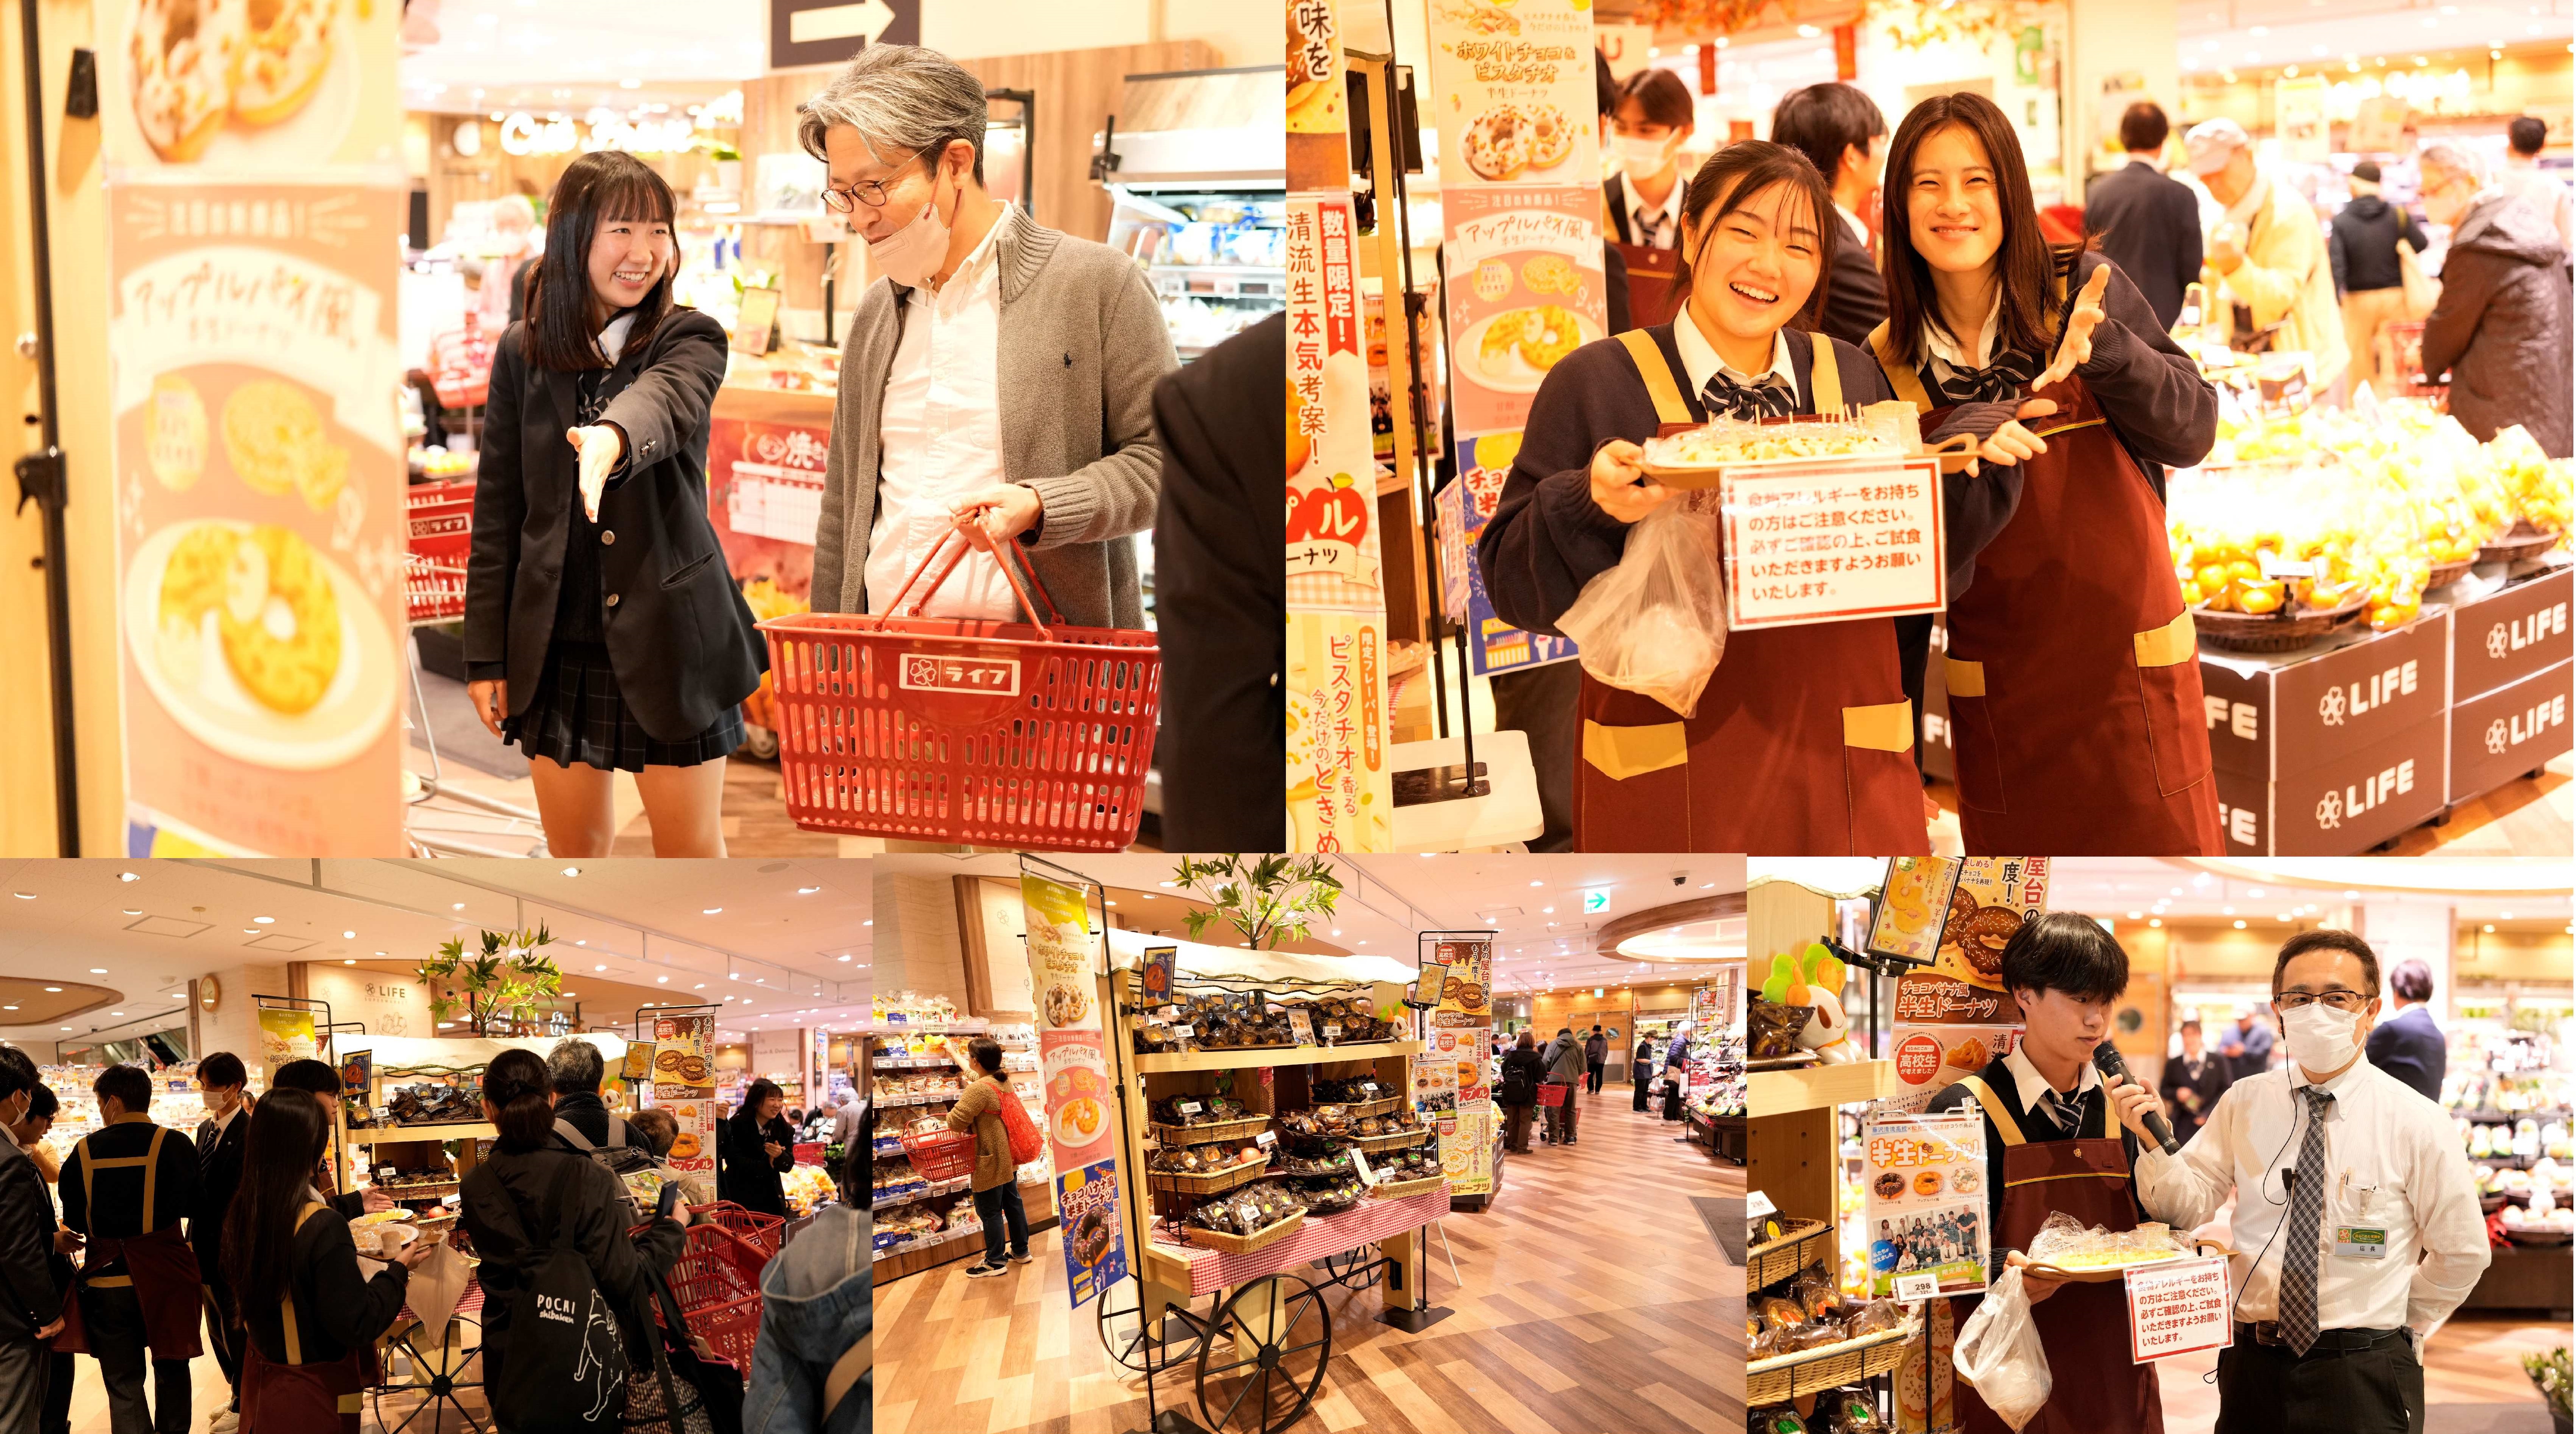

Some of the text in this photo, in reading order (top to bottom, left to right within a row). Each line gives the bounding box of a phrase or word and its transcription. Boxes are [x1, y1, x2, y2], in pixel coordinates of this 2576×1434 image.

[1300, 1, 1332, 77] 味を
[1475, 62, 1559, 84] ピスタチオ
[1487, 87, 1548, 99] 半生ドーナツ
[1466, 215, 1585, 242] アップルパイ風
[431, 519, 465, 532] ライフ
[1749, 508, 1914, 531] の方はご注意ください。
[1750, 529, 1921, 555] 必ずご確認の上、ご試食
[1751, 552, 1921, 577] いただきますようお願い
[1752, 581, 1836, 601] いたします。
[2510, 602, 2567, 651] LIFE
[945, 667, 1006, 684] ライフ
[1361, 632, 1379, 763] 限定フレーバー登場!
[2351, 659, 2418, 716] LIFE
[1330, 635, 1358, 815] ピスタチオ香る
[2510, 694, 2565, 745] LIFE
[2346, 758, 2415, 818] LIFE
[2002, 862, 2020, 902] 度!
[1481, 944, 1490, 1005] あの屋台の味を
[380, 986, 405, 998] LIFE
[1901, 980, 1970, 997] チョコバナナ風
[1898, 995, 1998, 1018] 半生ドーナツ
[1437, 1017, 1476, 1026] 半生ドーナツ
[703, 1018, 714, 1077] あの屋台の味を
[1050, 1042, 1097, 1063] アップルパイ風
[1900, 1054, 1936, 1068] 高校生
[655, 1090, 698, 1098] 半生ドーナツ
[1459, 1099, 1482, 1107] 半生ドーナツ
[1870, 1138, 1980, 1168] 半生ドーナツ
[1061, 1176, 1116, 1207] チョコバナナ風
[1065, 1189, 1113, 1219] 半生ドーナツ
[1942, 1265, 1974, 1275] 限定販売!
[537, 1294, 576, 1314] POCHI
[2140, 1287, 2217, 1305] の方はご注意ください。
[539, 1310, 575, 1324] shibaken
[2141, 1298, 2221, 1320] 必ずご確認の上、ご試食
[2142, 1313, 2221, 1333] いただきますようお願い
[2143, 1332, 2183, 1346] いたします。
